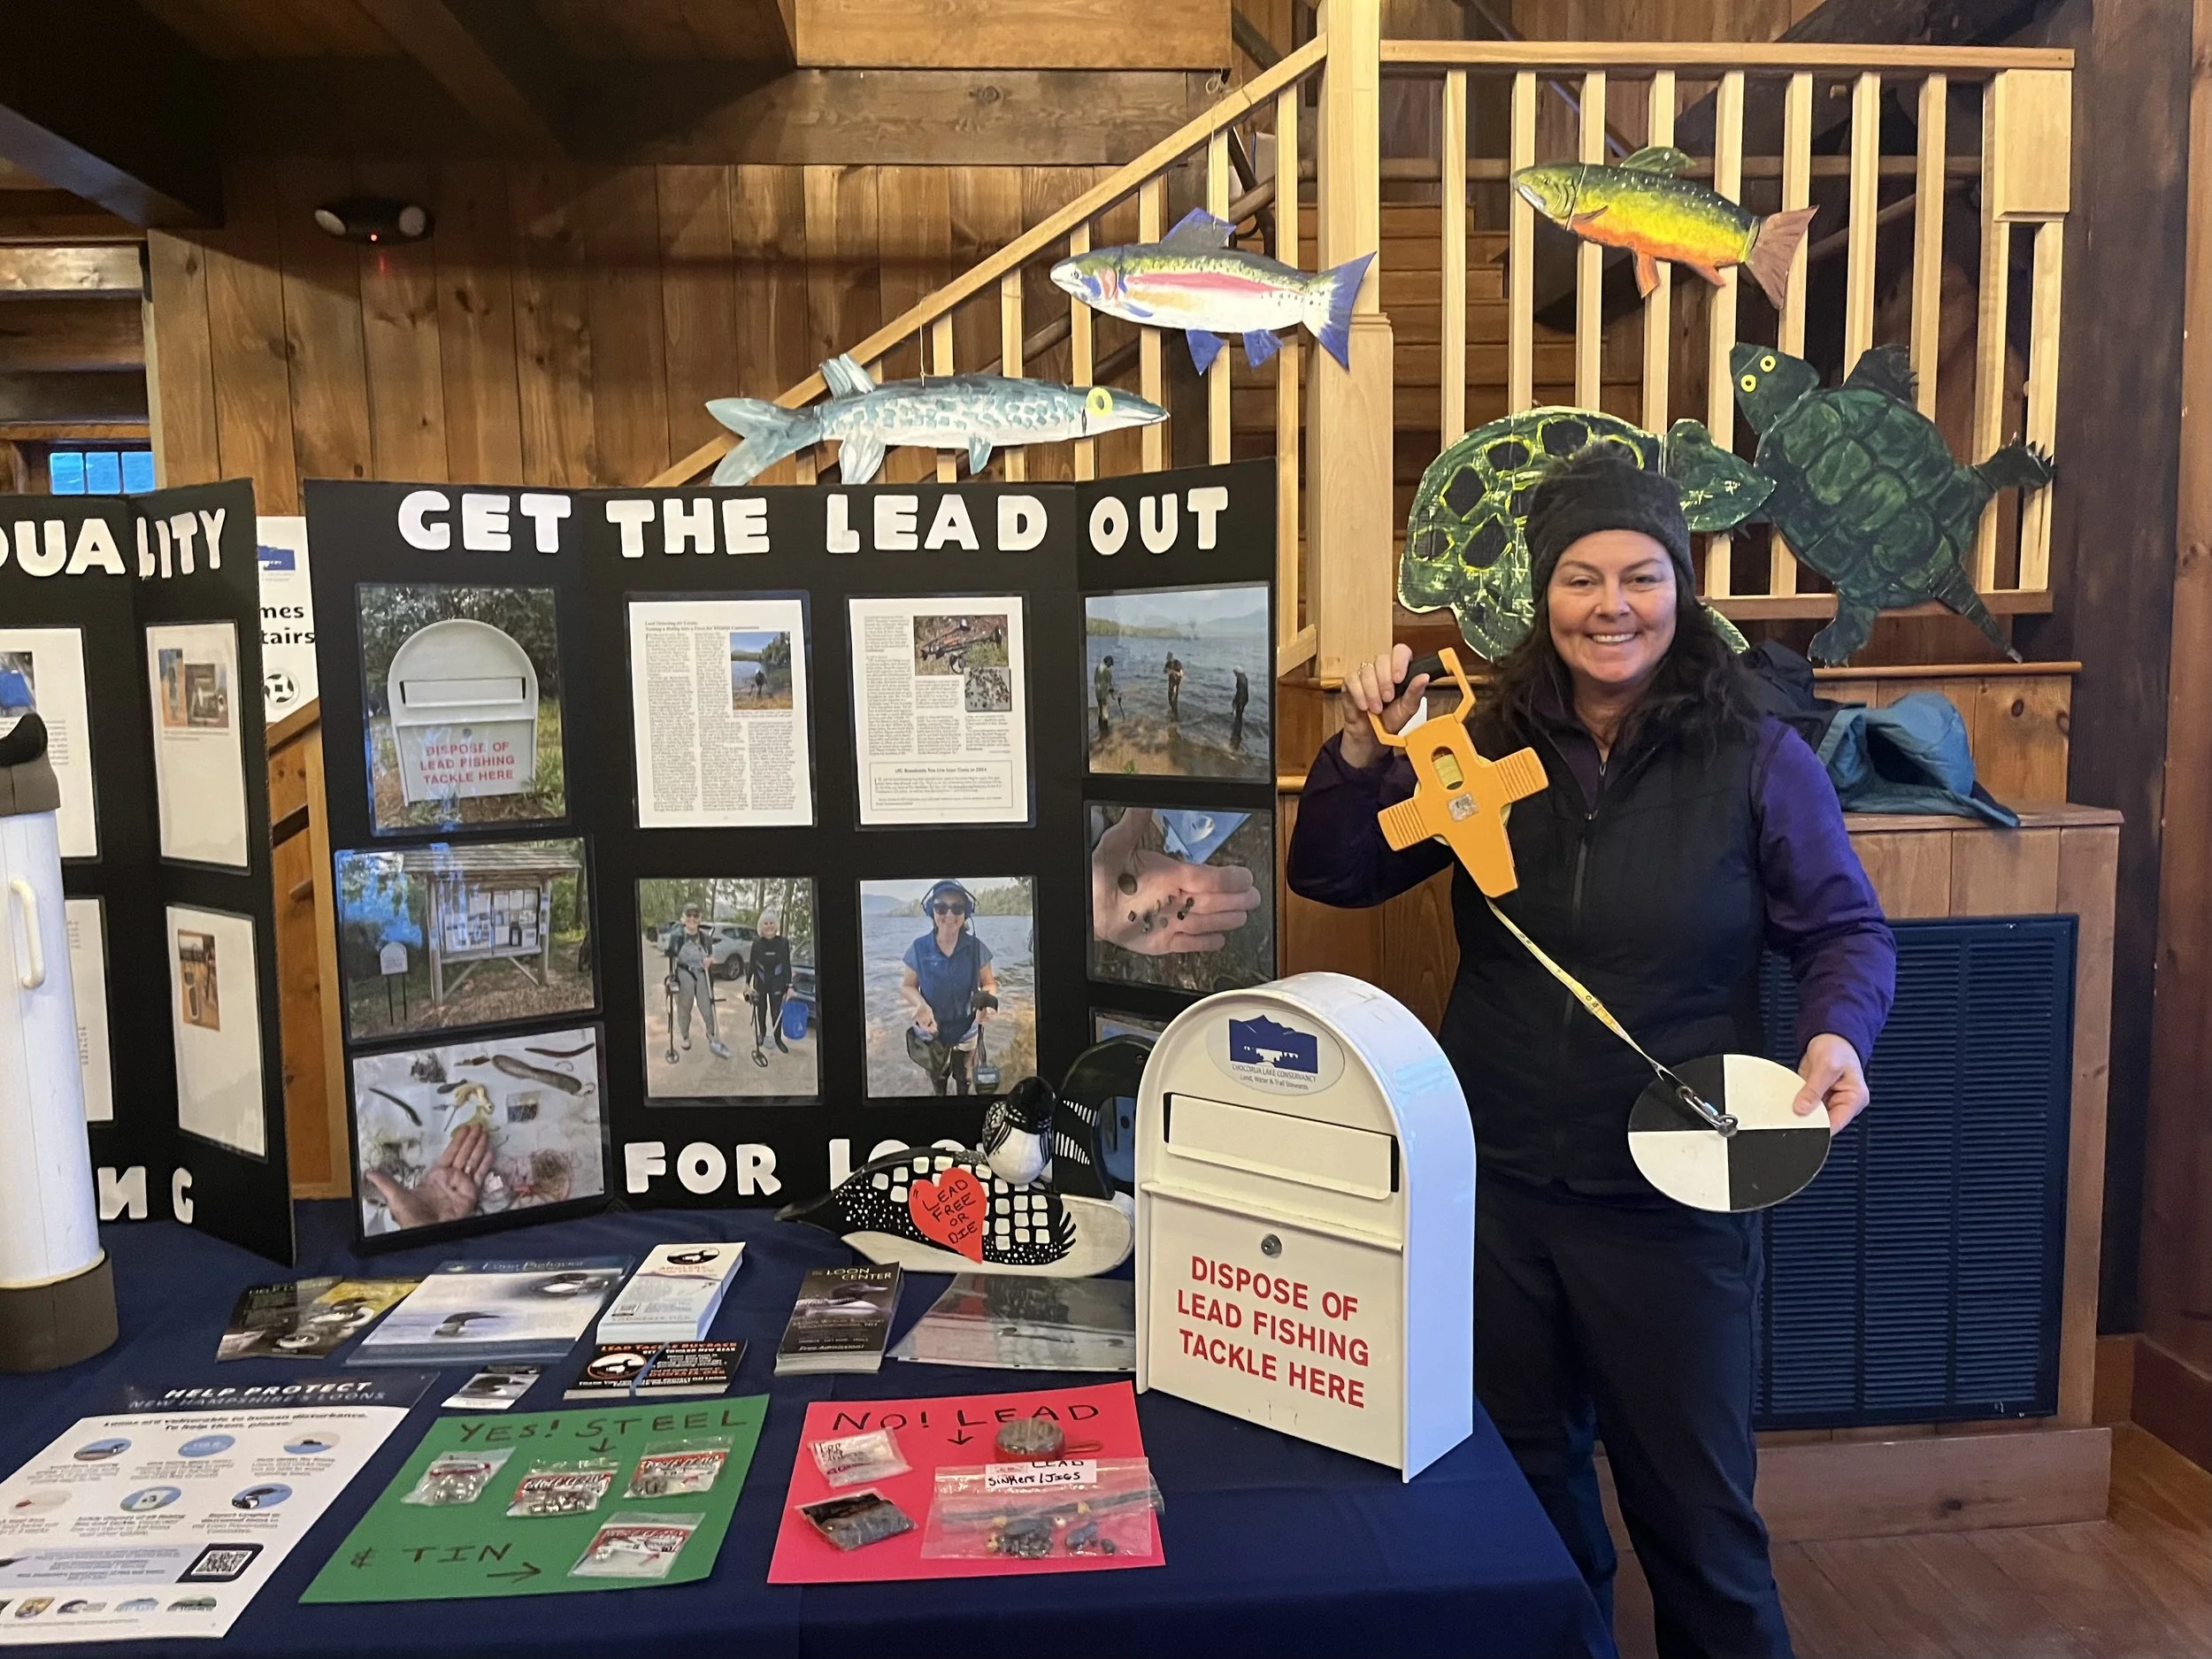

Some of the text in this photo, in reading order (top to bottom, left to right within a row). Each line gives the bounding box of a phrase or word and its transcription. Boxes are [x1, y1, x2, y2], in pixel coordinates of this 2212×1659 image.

[398, 486, 1228, 558] GET THE LEAD OUT
[0, 508, 226, 581] UALITY
[493, 741, 510, 752] OF
[420, 755, 515, 771] LEAD FISHING
[424, 770, 513, 785] TACKLE HERE
[1263, 1067, 1276, 1077] LAKE
[1277, 1070, 1317, 1083] CONSERVANCY
[624, 1141, 782, 1196] FOR
[921, 1179, 969, 1211] LEAD
[932, 1192, 977, 1223] FREE
[949, 1212, 970, 1226] OR
[948, 1220, 978, 1245] DIE
[826, 1267, 870, 1276] LOON
[841, 1271, 892, 1281] CENTER
[1191, 1256, 1358, 1321] DISPOSE OF
[1178, 1289, 1369, 1367] LEAD FISHING
[1179, 1328, 1364, 1409] TACKLE HERE
[165, 1381, 372, 1399] HELP PROTECT
[318, 1392, 386, 1402] LOONS
[460, 1409, 748, 1442] YES! STEEL
[832, 1404, 1099, 1432] NO! LEAD
[402, 1543, 513, 1563] TIN
